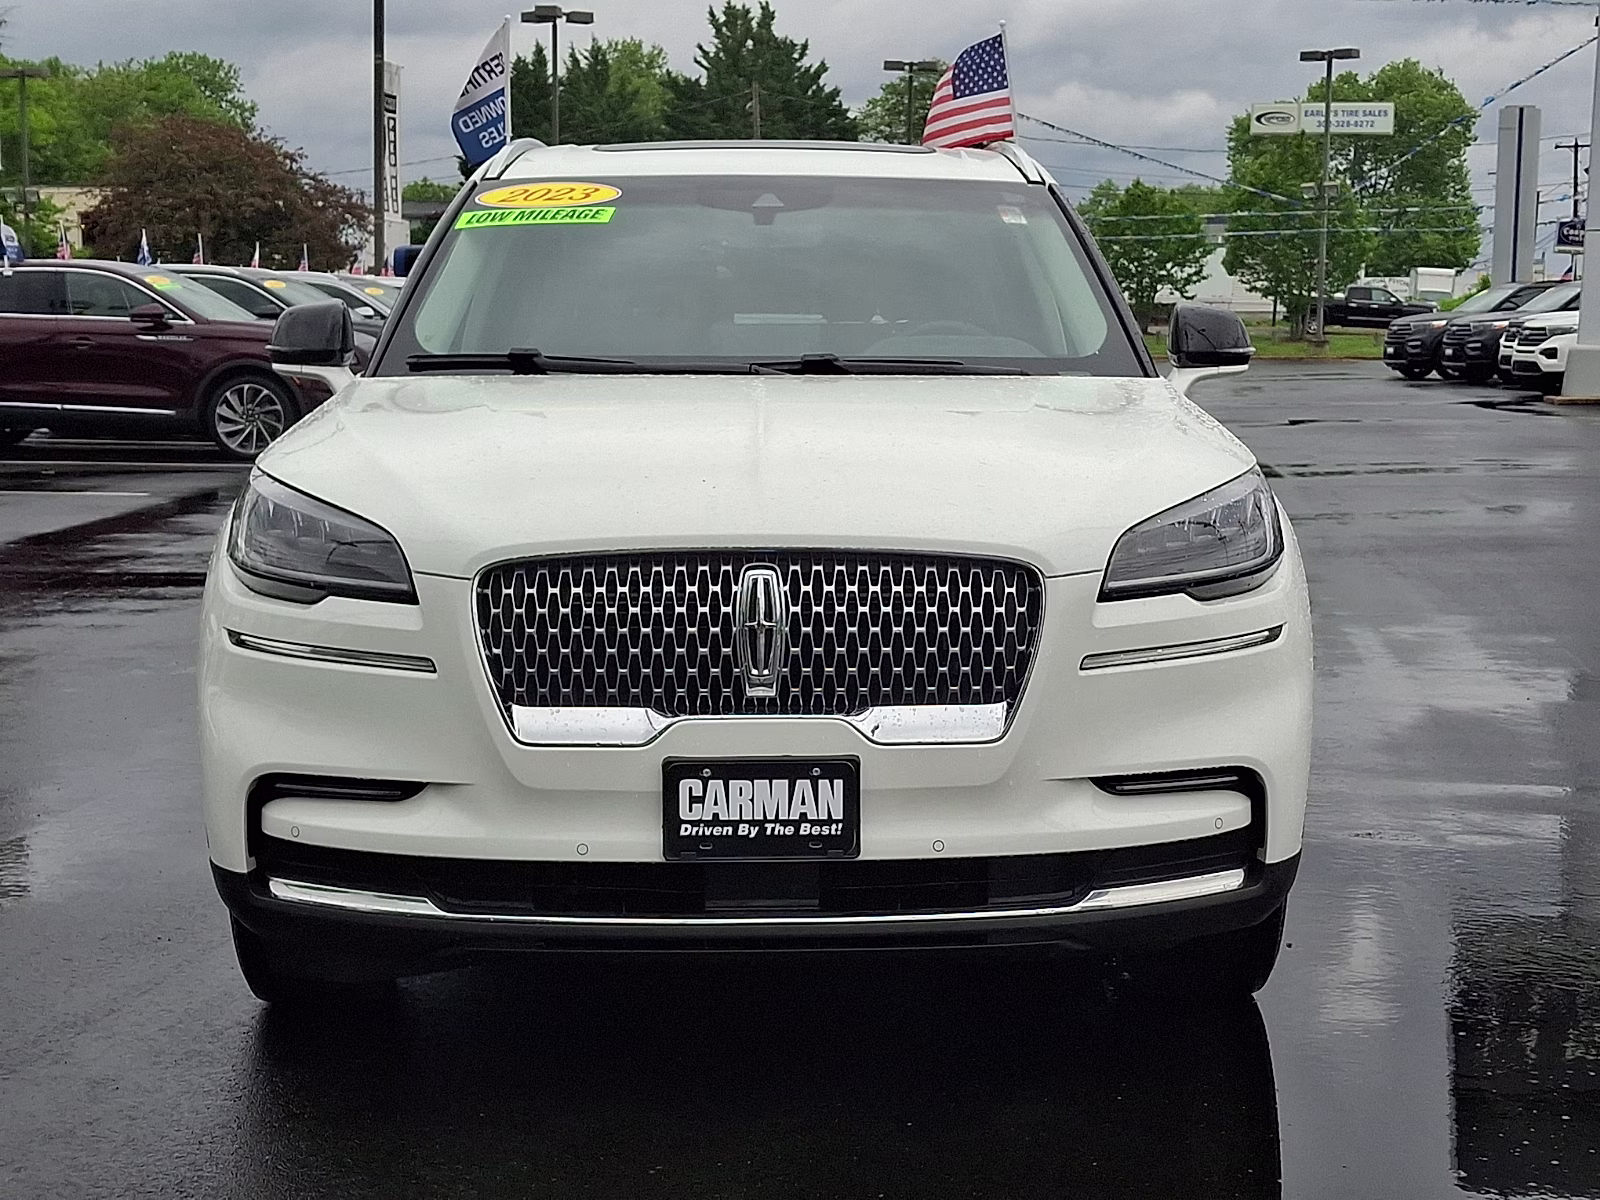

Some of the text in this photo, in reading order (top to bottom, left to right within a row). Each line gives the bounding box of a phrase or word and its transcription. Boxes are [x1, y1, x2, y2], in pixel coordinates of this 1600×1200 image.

[1304, 109, 1389, 118] EARL'S TIRE SALES
[497, 187, 600, 203] 2023
[465, 208, 605, 225] LOW MILEAGE
[678, 778, 844, 821] CARMAN
[679, 822, 843, 838] Driven By The Best!
